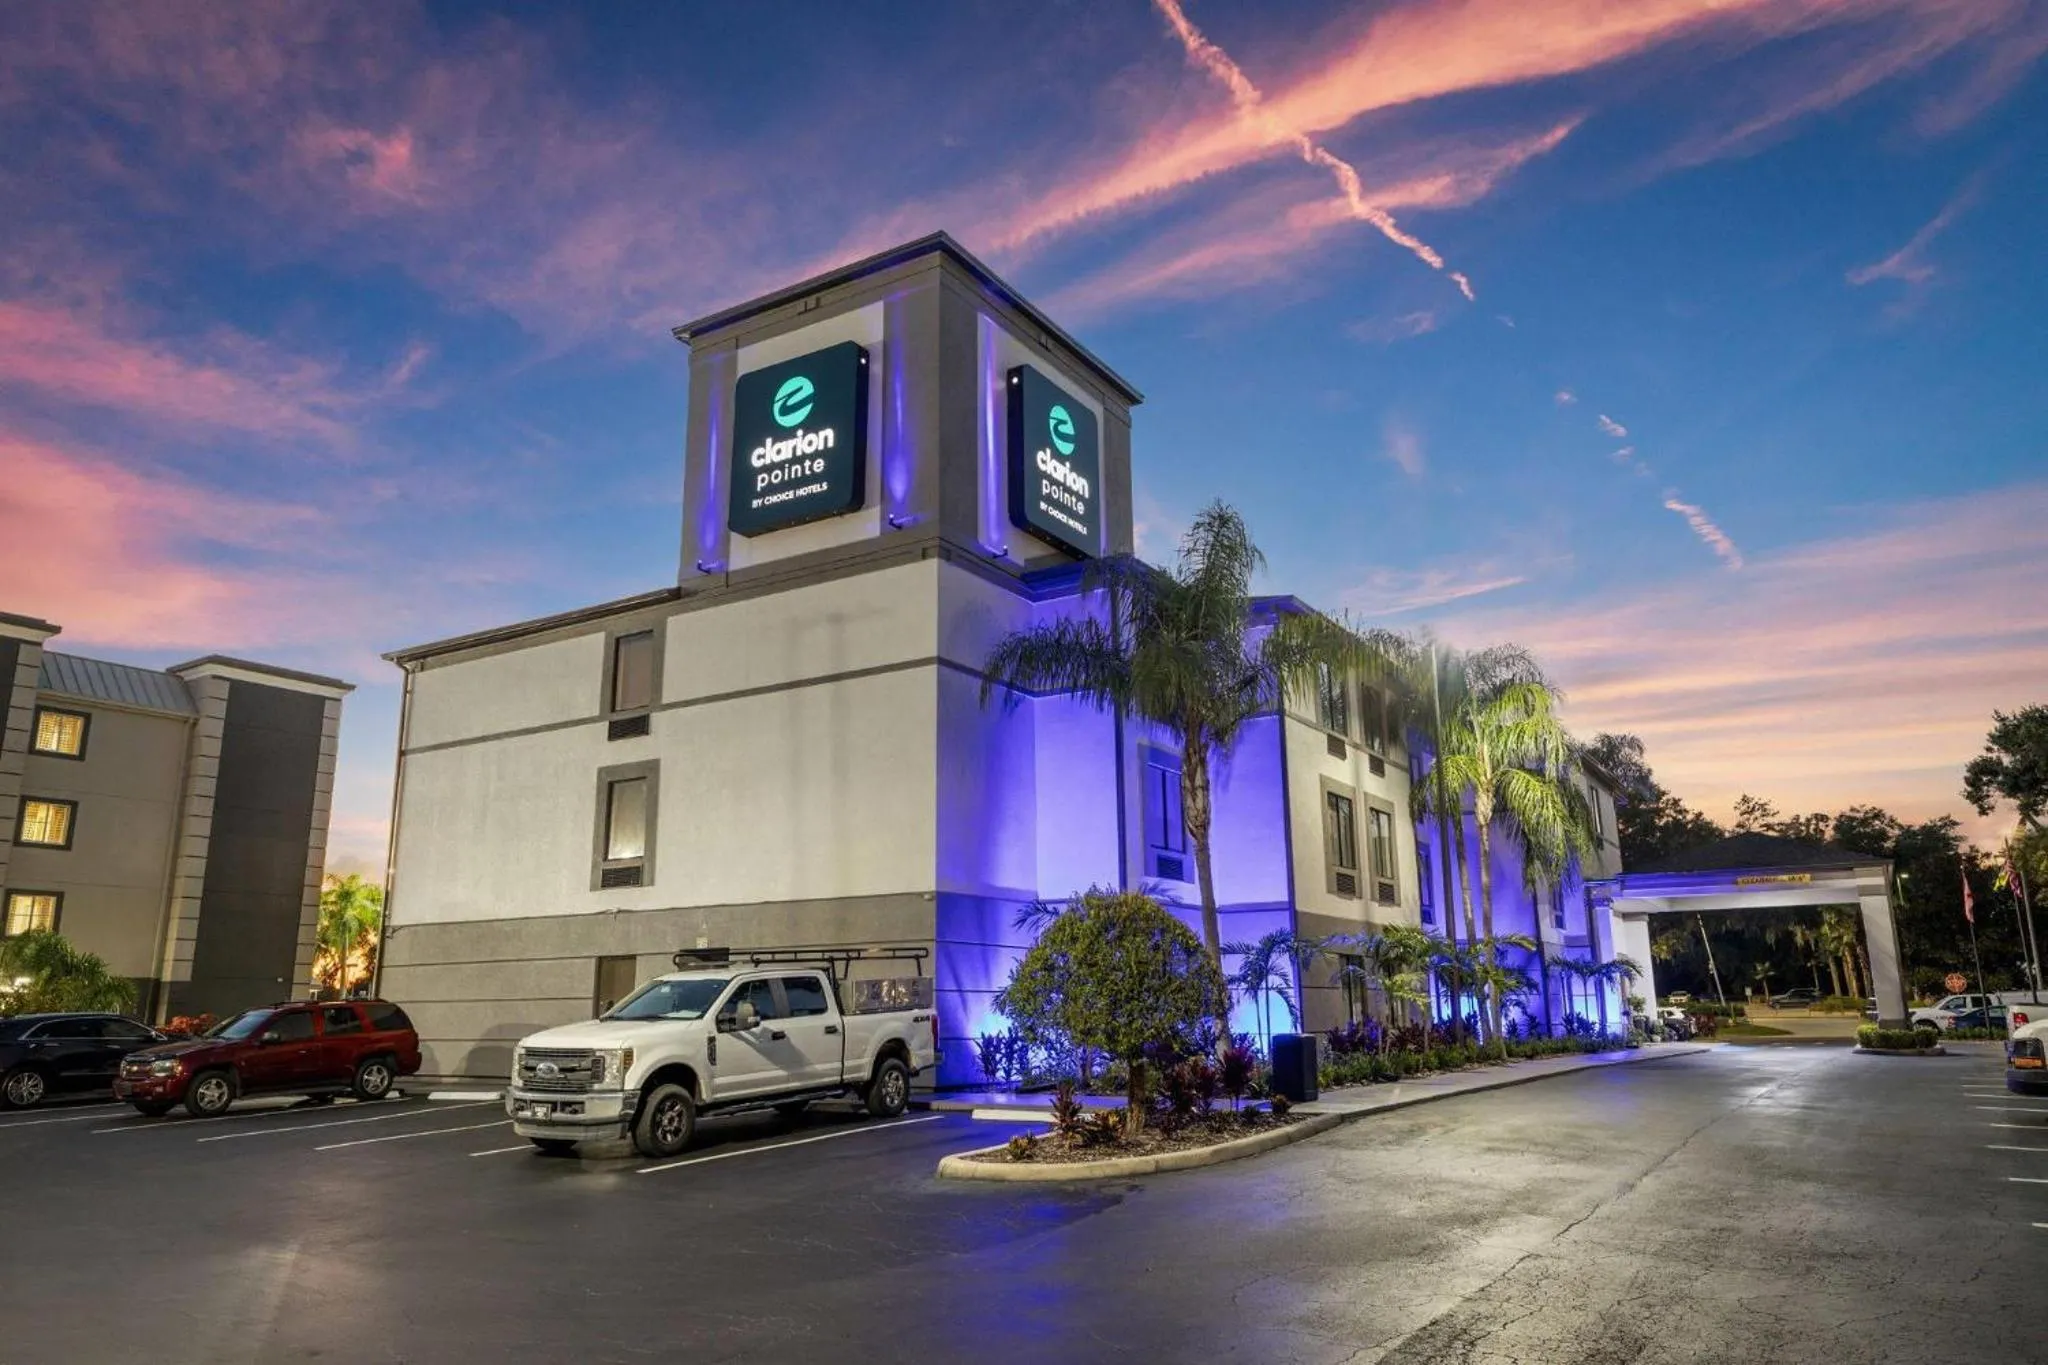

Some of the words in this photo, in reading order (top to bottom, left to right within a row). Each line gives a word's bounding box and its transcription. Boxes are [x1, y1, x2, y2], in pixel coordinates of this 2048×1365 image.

[751, 427, 835, 468] clarion
[757, 458, 825, 491] pointe
[1036, 448, 1090, 499] clarion
[752, 498, 763, 509] BY
[764, 490, 794, 505] CHOICE
[795, 481, 828, 497] HOTELS
[1042, 478, 1085, 515] pointe
